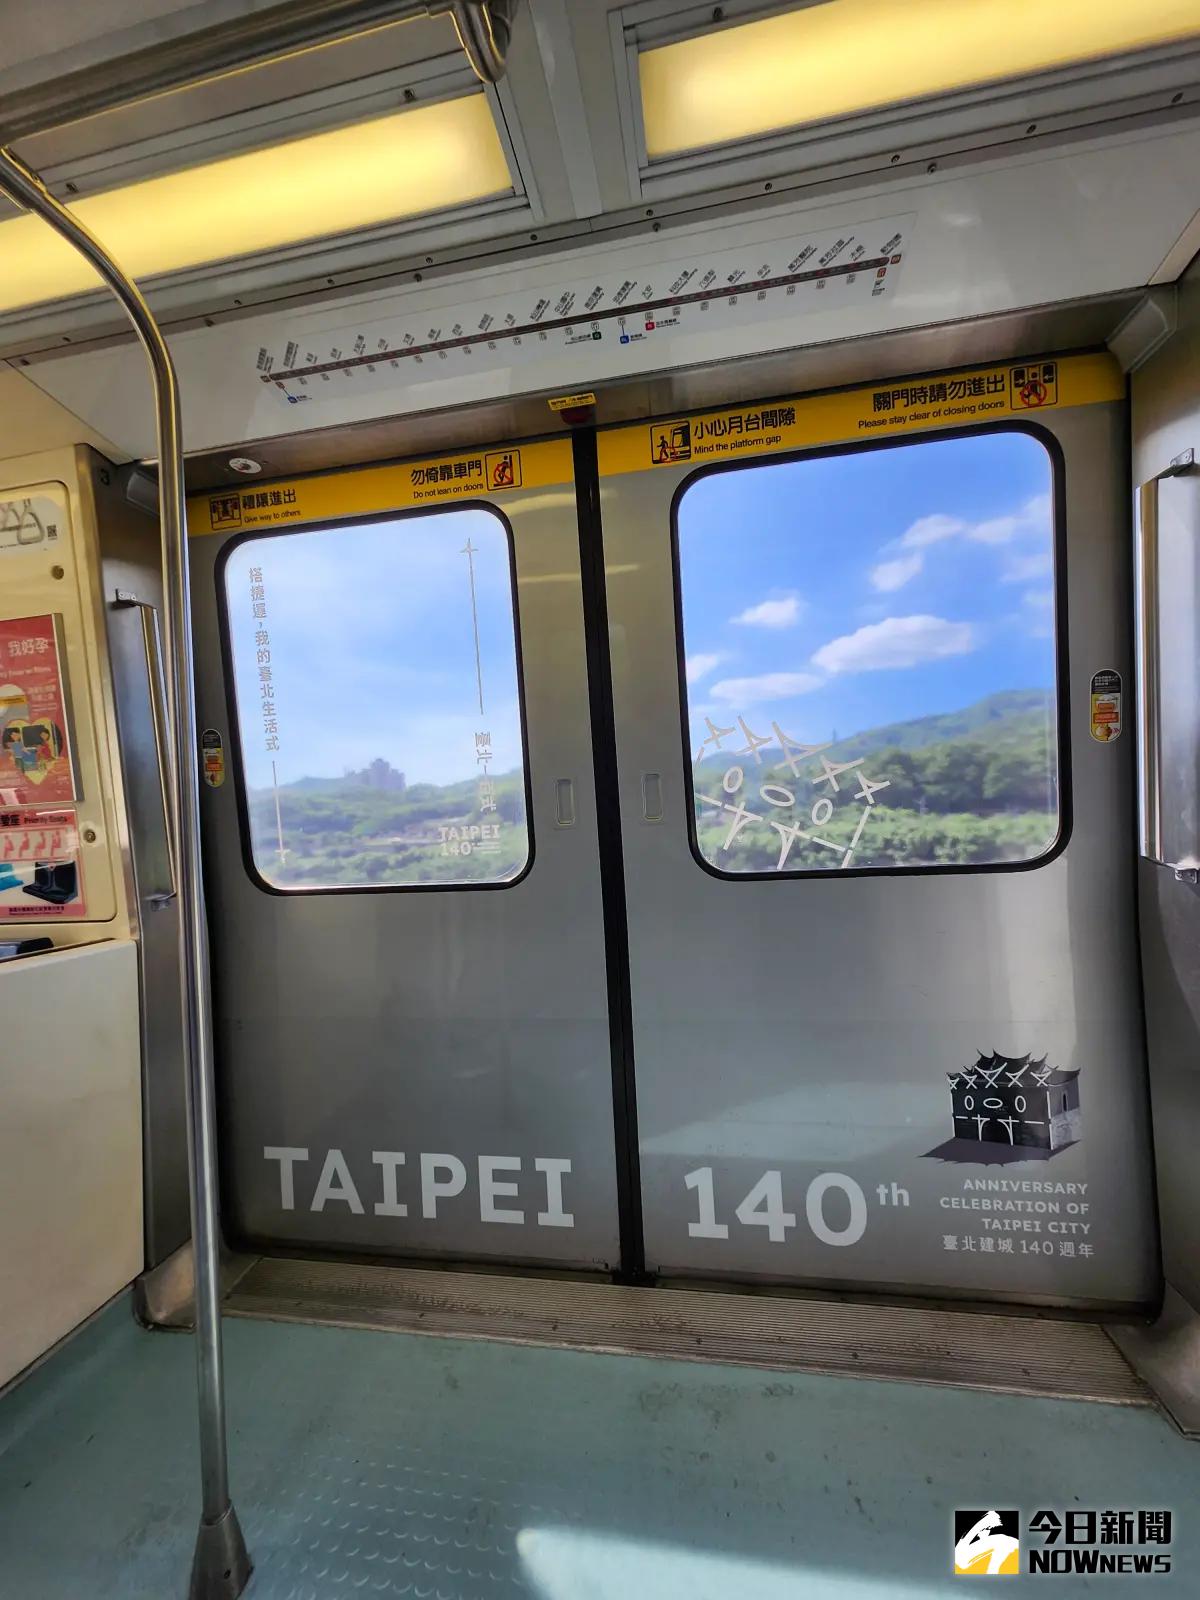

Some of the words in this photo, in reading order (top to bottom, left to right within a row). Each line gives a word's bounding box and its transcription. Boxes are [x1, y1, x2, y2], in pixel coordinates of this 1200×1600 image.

[872, 374, 1005, 412] 關門時請勿進出
[694, 407, 796, 440] 小心月台間隙
[858, 417, 887, 429] Please
[888, 414, 907, 425] stay
[909, 411, 929, 422] clear
[933, 408, 942, 418] of
[943, 403, 976, 416] closing
[978, 400, 1005, 411] doors
[694, 443, 714, 455] Mind
[715, 441, 729, 452] the
[730, 436, 764, 451] platform
[765, 434, 782, 446] gap
[410, 459, 483, 486] 勿倚靠車門
[413, 490, 424, 499] Do
[424, 488, 436, 497] not
[437, 486, 450, 495] lean
[453, 485, 462, 494] on
[463, 482, 484, 491] doors
[259, 512, 272, 522] way
[273, 511, 280, 519] to
[281, 508, 301, 518] others
[438, 824, 501, 843] TAIPEI
[264, 1146, 574, 1228] TAIPEI
[963, 1178, 1089, 1195] ANNIVERSARY
[939, 1196, 1061, 1214] CELEBRATION
[1066, 1202, 1091, 1215] OF
[981, 1217, 1043, 1233] TAIPEI
[1047, 1221, 1091, 1235] CITY
[942, 1234, 1015, 1254] 臺北建城
[1020, 1239, 1055, 1256] 140
[1059, 1240, 1095, 1259] 週年
